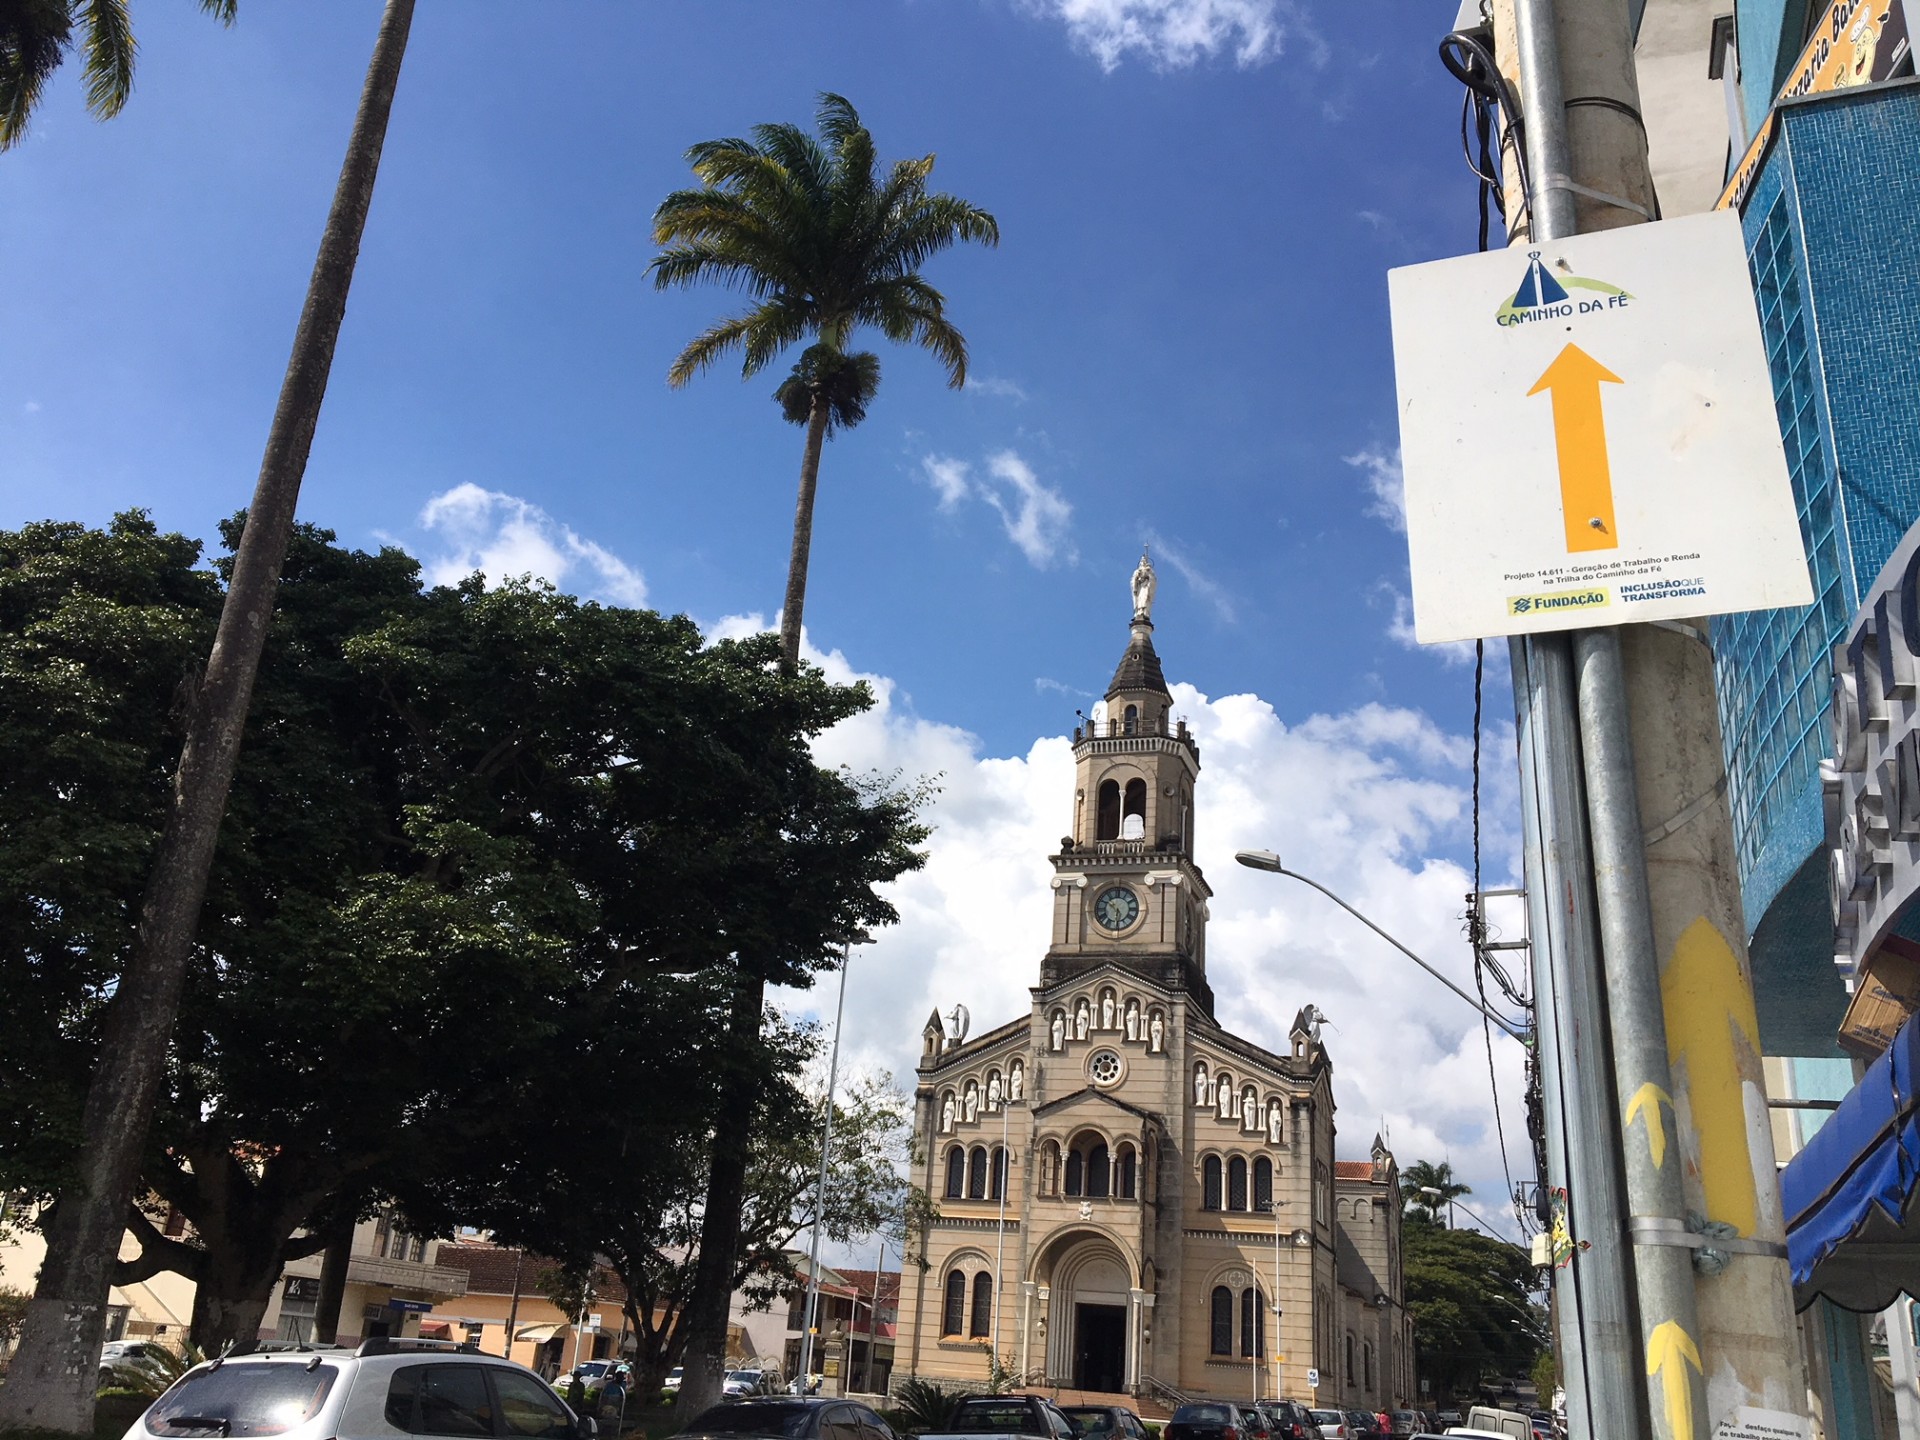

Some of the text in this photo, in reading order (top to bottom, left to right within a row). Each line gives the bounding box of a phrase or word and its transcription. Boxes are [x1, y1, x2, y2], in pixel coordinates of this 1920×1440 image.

[1496, 290, 1629, 327] CAMINHO DA FÉ
[1504, 571, 1535, 581] Projeto
[1537, 568, 1563, 577] 14.611
[1571, 563, 1608, 574] Geração
[1610, 561, 1621, 570] de
[1623, 556, 1662, 567] Trabalho
[1671, 552, 1701, 562] Renda
[1556, 573, 1580, 584] Trilha
[1582, 573, 1594, 581] do
[1595, 569, 1635, 579] Caminho
[1637, 566, 1649, 575] da
[1651, 565, 1662, 573] Fé
[1534, 591, 1604, 610] FUNDAÇÃO
[1621, 586, 1706, 603] TRANSFORMA
[1730, 1431, 1760, 1440] trabalho
[1745, 1423, 1771, 1434] desfaço
